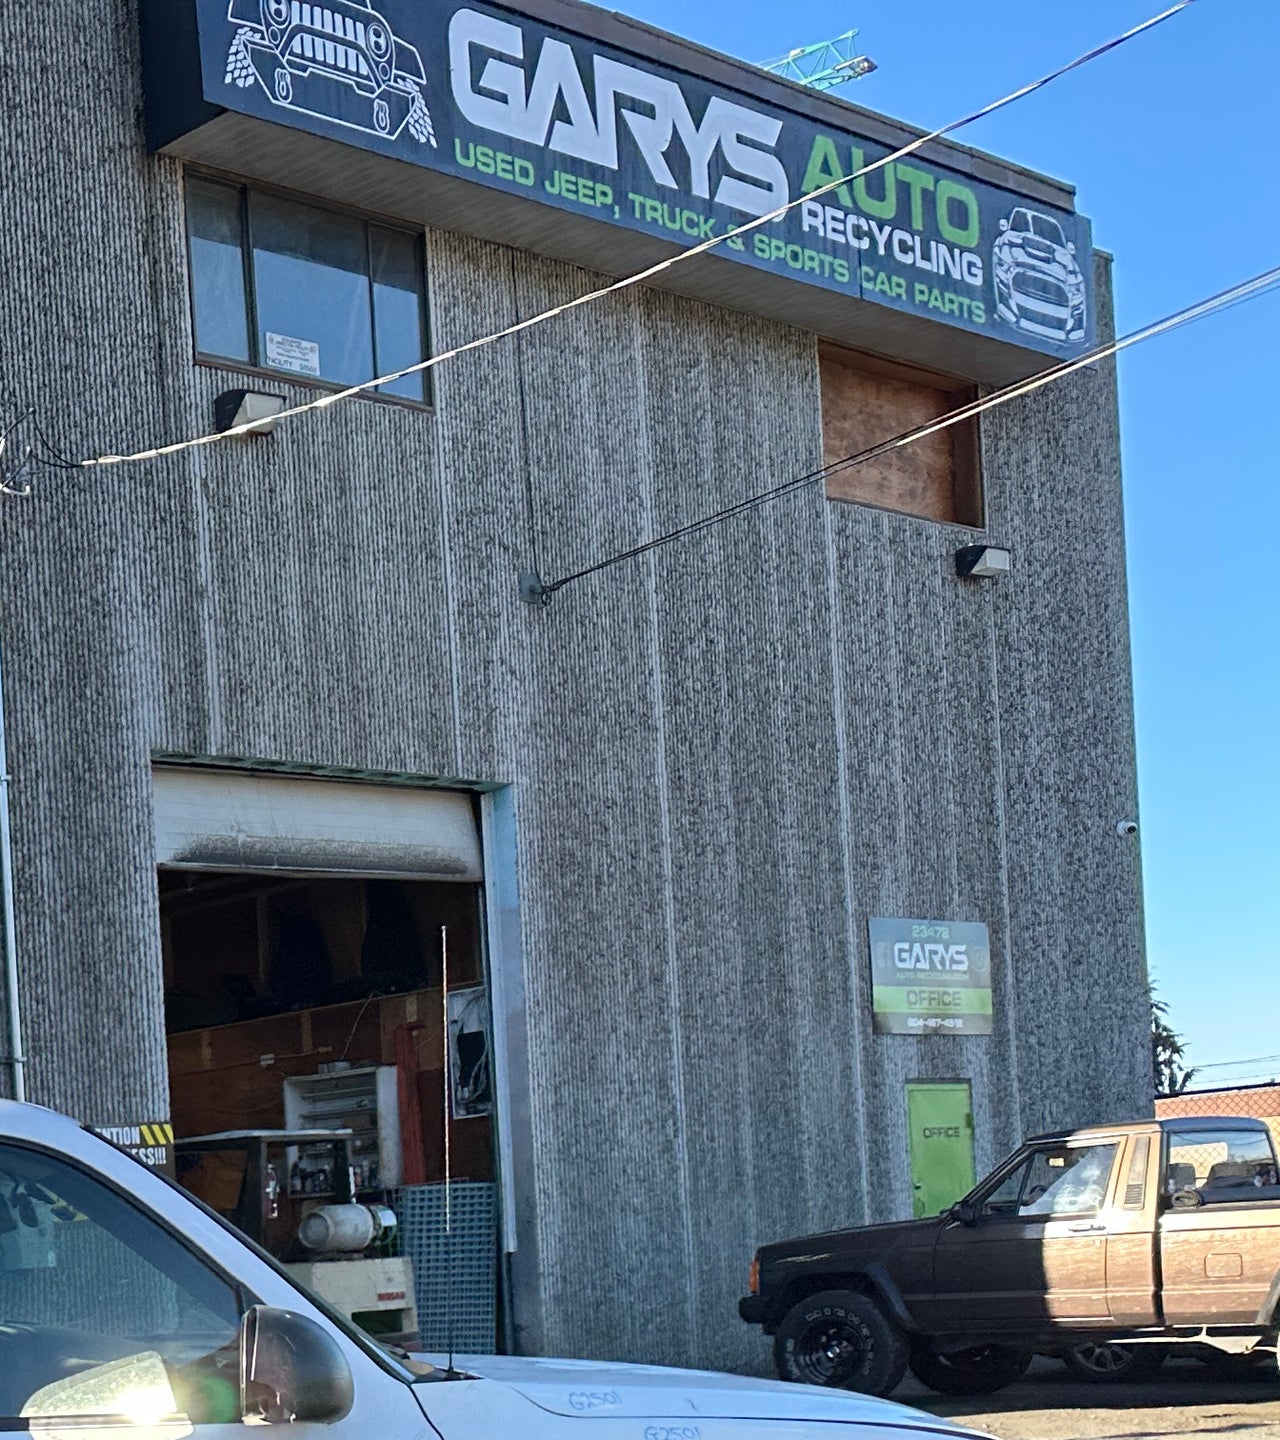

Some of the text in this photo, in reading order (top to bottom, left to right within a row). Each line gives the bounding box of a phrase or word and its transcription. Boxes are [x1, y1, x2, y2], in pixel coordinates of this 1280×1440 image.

[448, 8, 789, 222] GARYS
[801, 134, 980, 248] AUTO
[454, 138, 535, 187] USED
[544, 170, 620, 219] JEEP,
[628, 193, 716, 239] TRUCK
[753, 233, 850, 284] SPORTS
[859, 265, 907, 301] CAR
[914, 283, 987, 324] PARTS
[802, 200, 983, 286] RECYCLING
[894, 942, 969, 971] GARYS
[906, 990, 962, 1007] OFFICE
[923, 1126, 961, 1138] OFFICE
[568, 1391, 622, 1411] G2501
